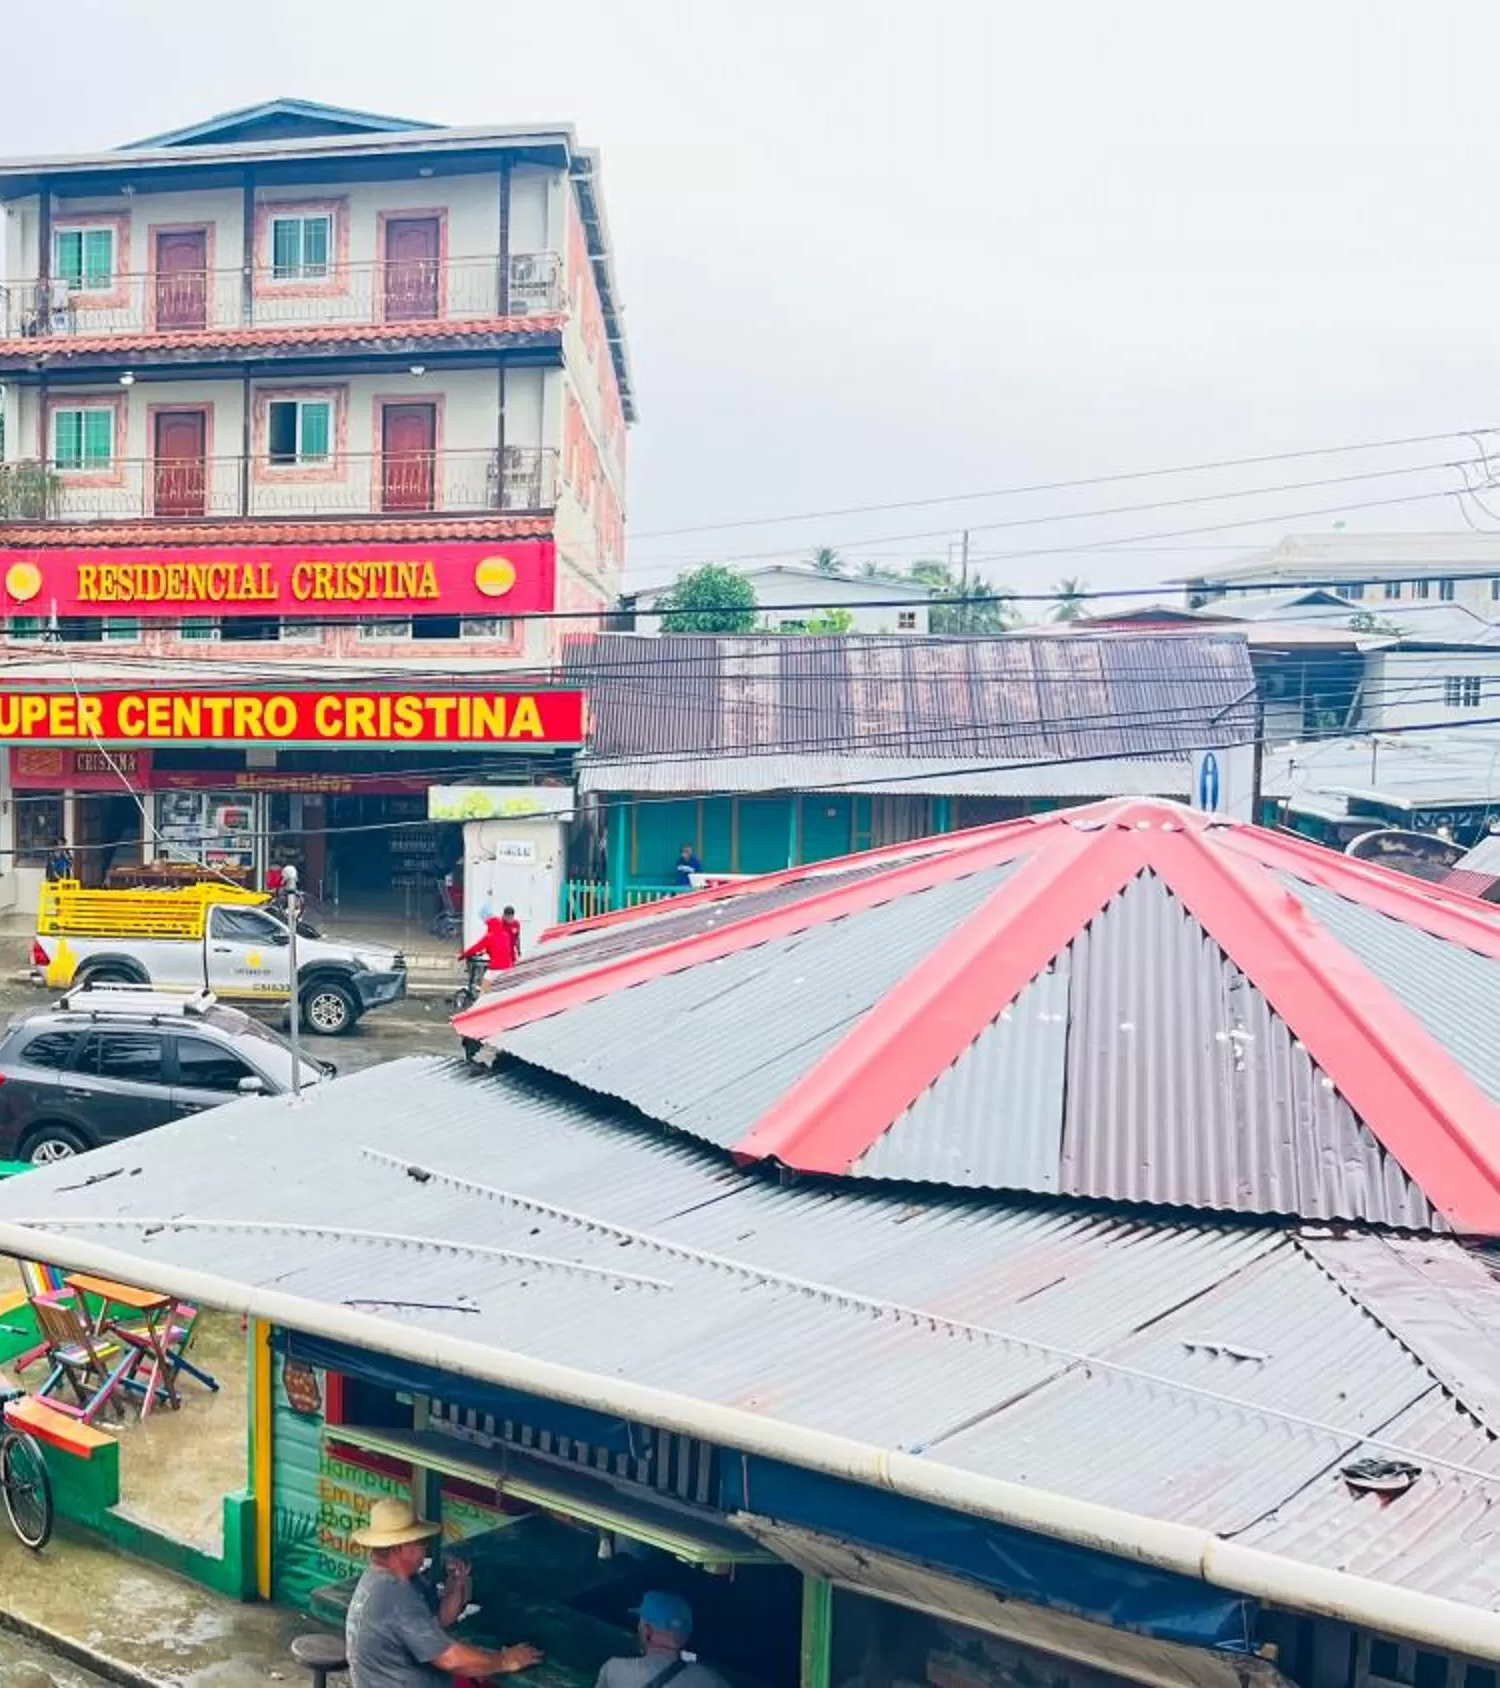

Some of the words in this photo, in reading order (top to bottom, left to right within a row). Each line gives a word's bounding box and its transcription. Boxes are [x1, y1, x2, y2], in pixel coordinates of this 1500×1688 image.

[77, 563, 278, 601] RESIDENCIAL
[292, 561, 440, 600] CRISTINA
[117, 695, 298, 738] CENTRO
[315, 695, 544, 738] CRISTINA
[76, 752, 136, 772] CRISTINA
